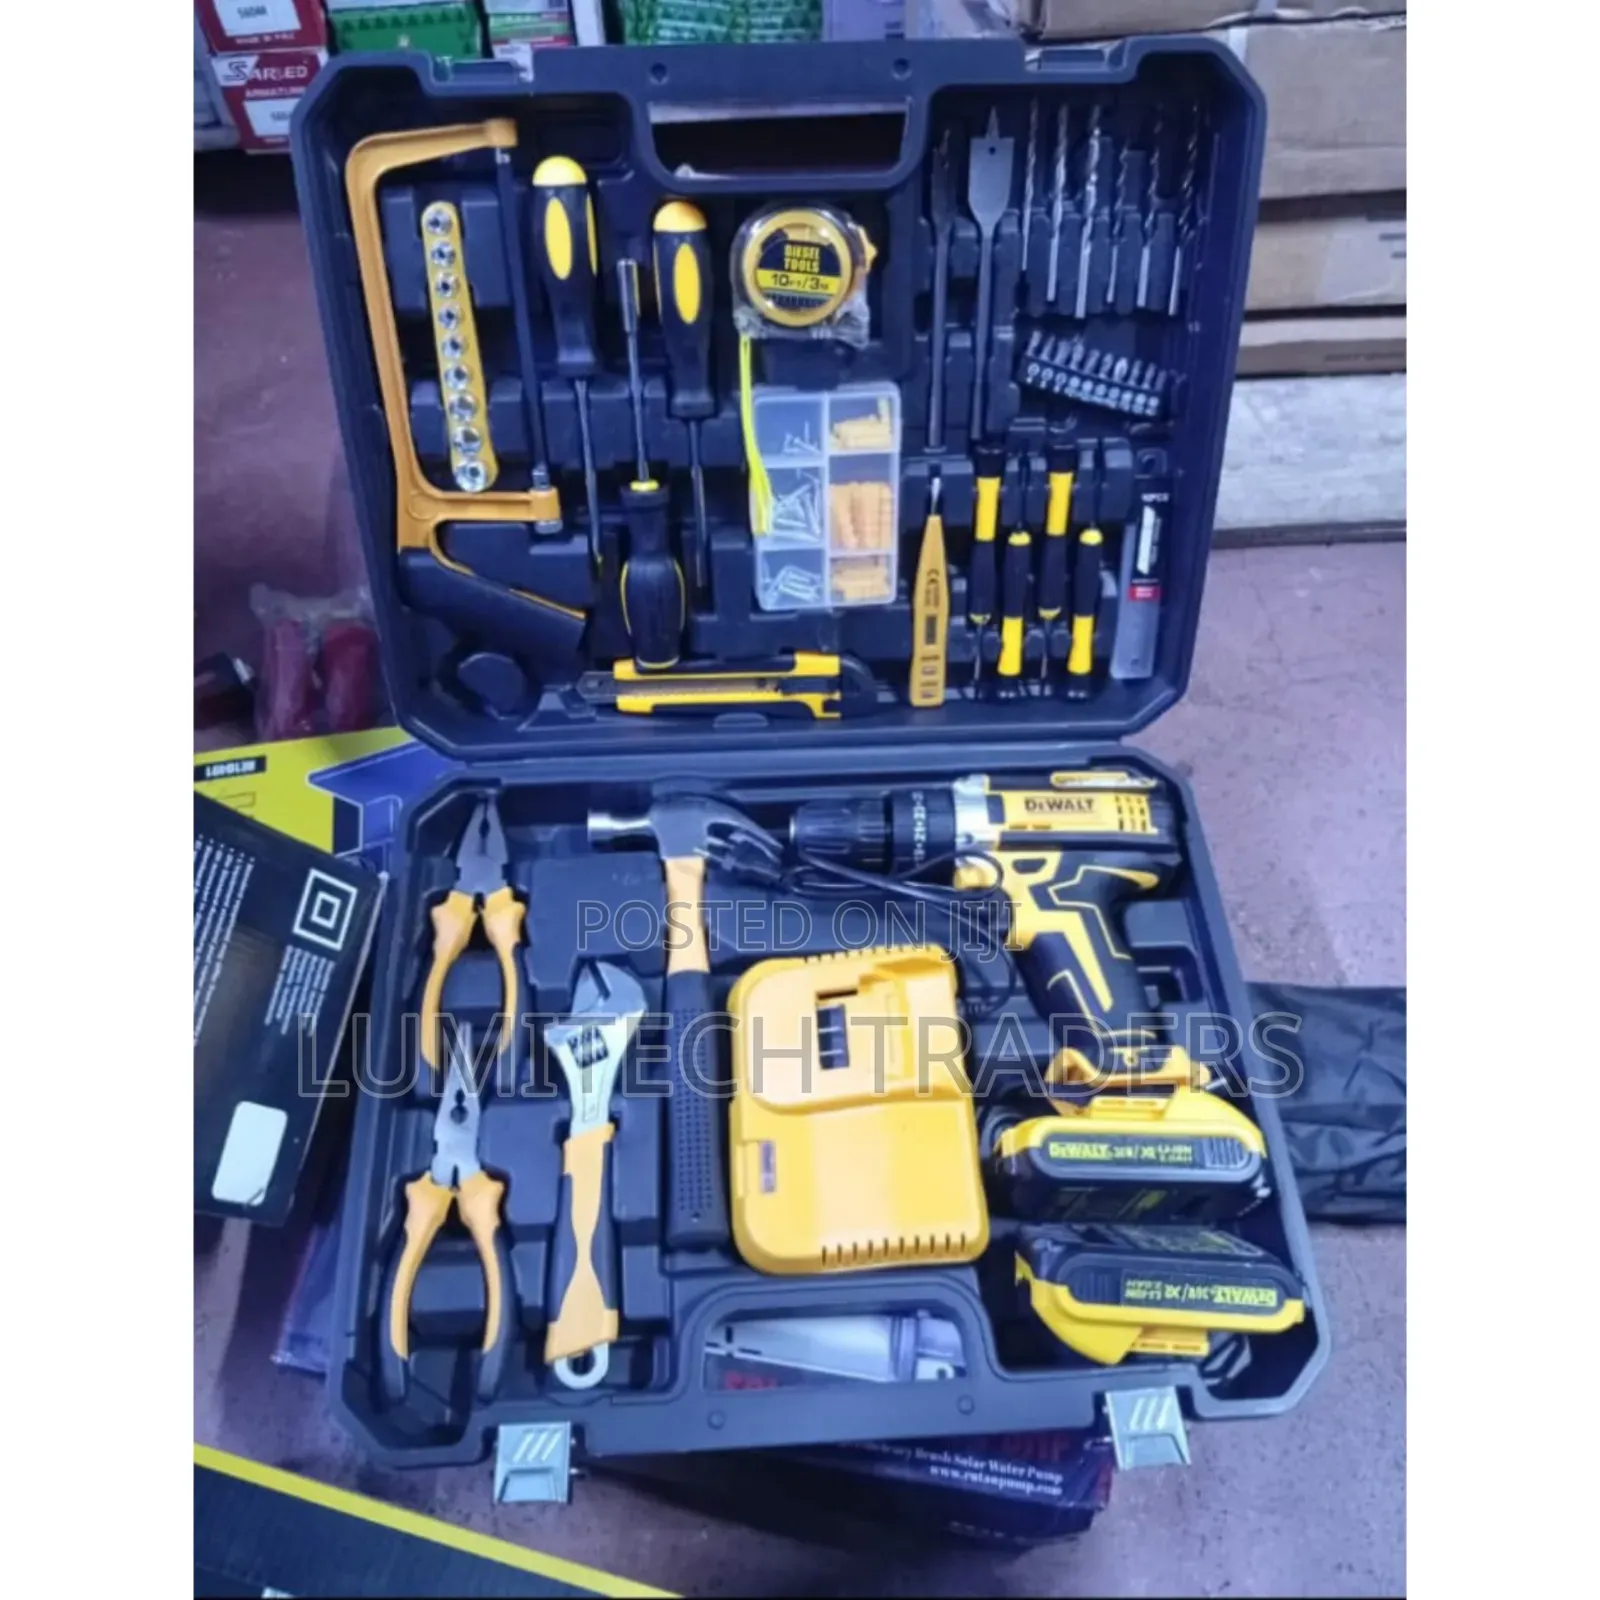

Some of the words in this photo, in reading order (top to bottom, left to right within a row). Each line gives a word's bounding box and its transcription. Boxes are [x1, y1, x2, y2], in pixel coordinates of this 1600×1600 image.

[954, 1454, 986, 1470] Solar
[988, 1459, 1026, 1477] Water
[1027, 1465, 1064, 1485] Pump
